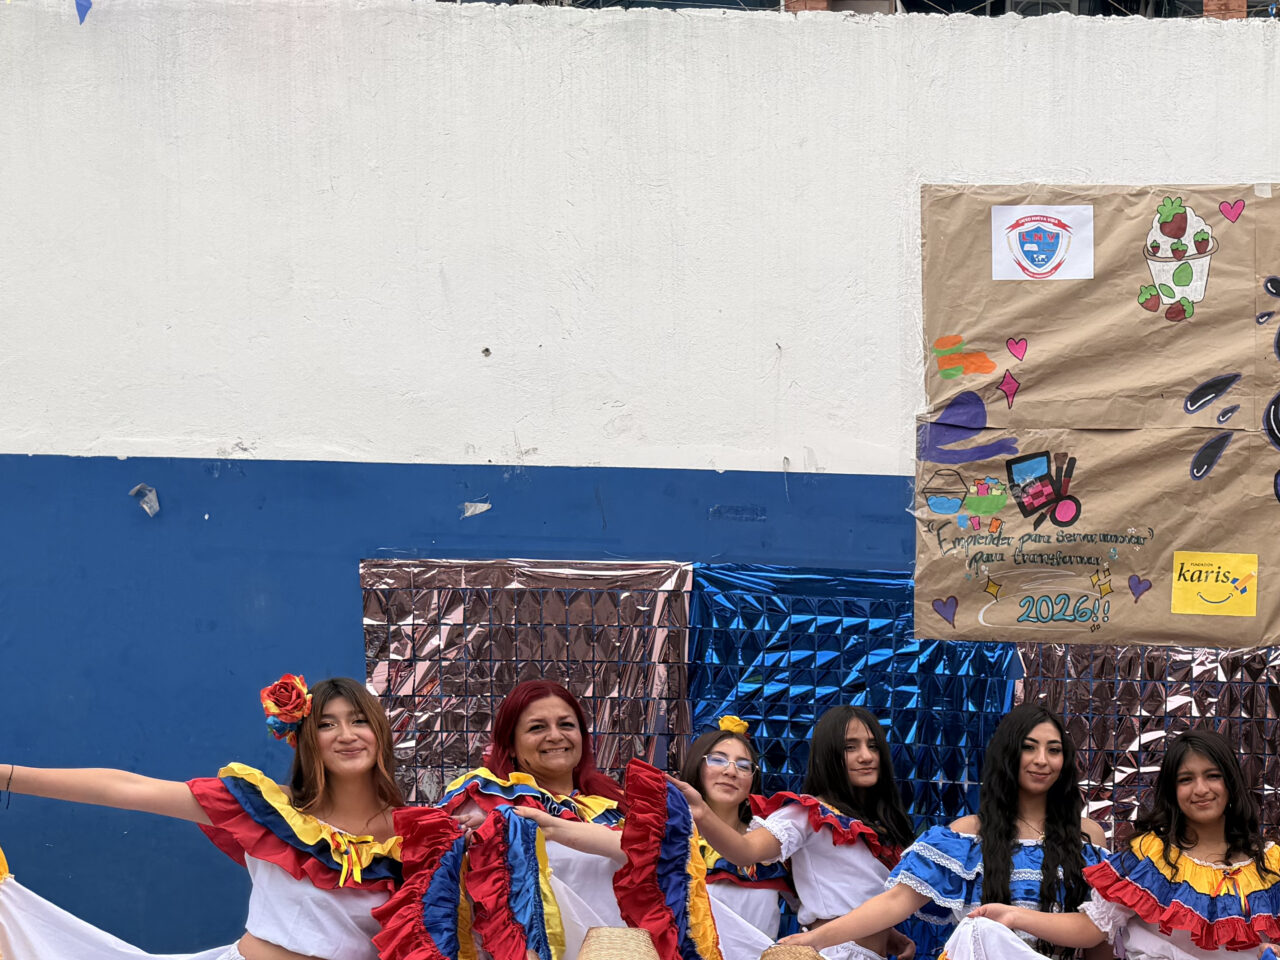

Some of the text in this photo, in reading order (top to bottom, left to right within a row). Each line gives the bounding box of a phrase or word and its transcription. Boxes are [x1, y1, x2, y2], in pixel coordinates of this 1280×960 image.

[1018, 529, 1052, 551] para
[1013, 547, 1103, 567] transformar
[1177, 562, 1231, 584] karis
[1016, 594, 1111, 623] 2026!!
